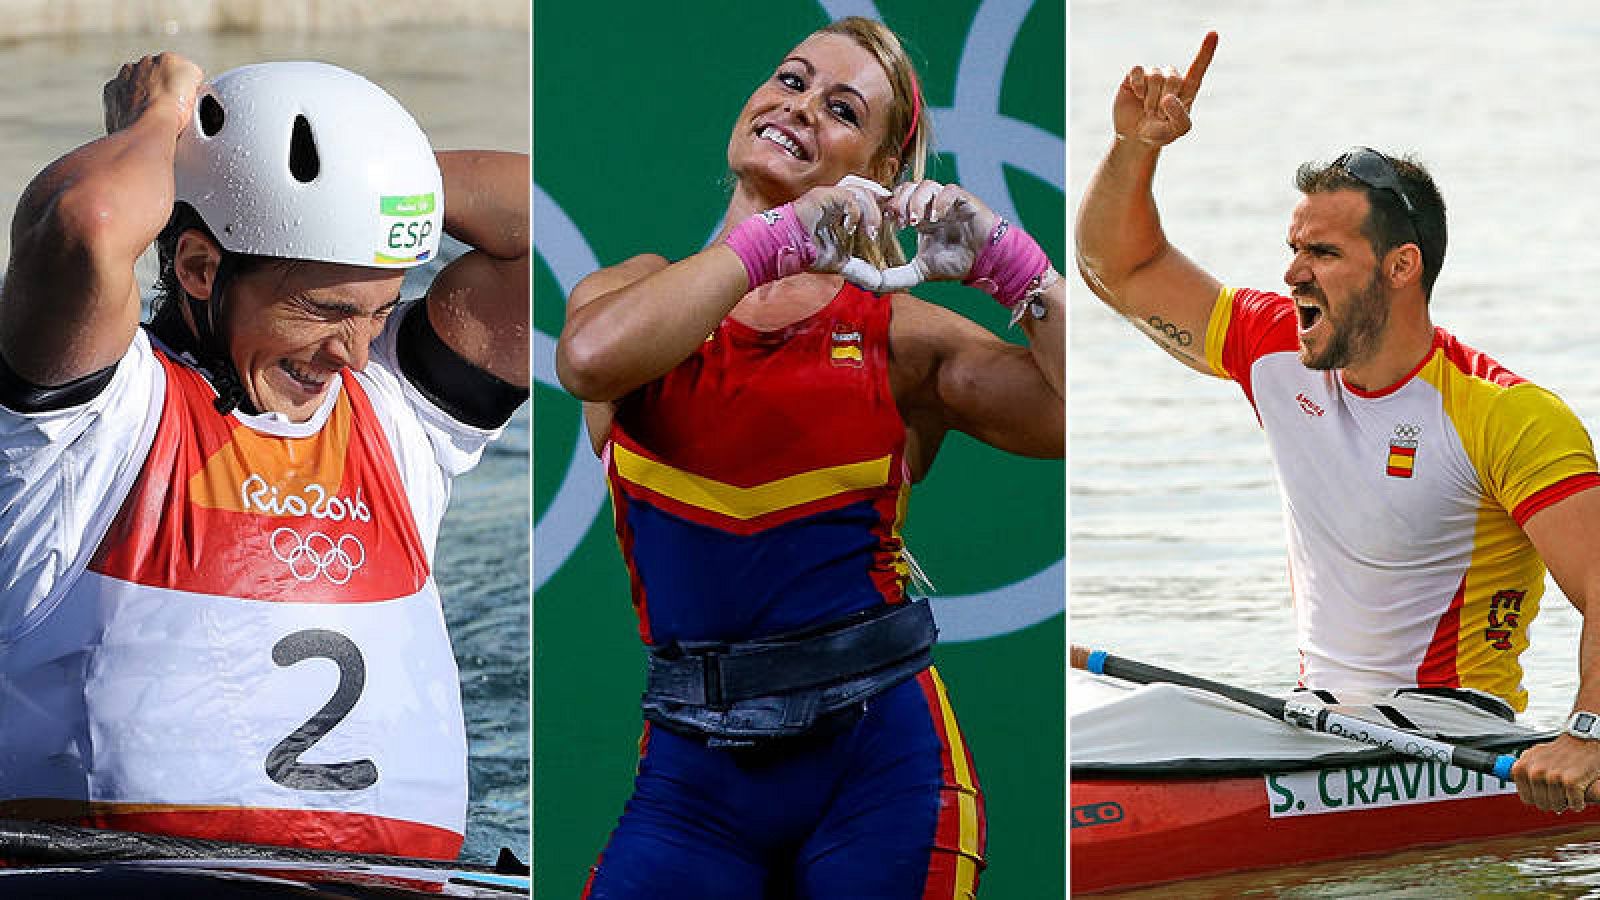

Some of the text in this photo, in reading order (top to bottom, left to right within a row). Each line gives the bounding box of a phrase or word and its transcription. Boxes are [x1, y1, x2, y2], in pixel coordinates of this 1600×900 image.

[388, 220, 433, 249] ESP
[1484, 589, 1527, 651] ESP
[266, 629, 378, 791] 2
[1269, 759, 1507, 813] S. CRAVIO
